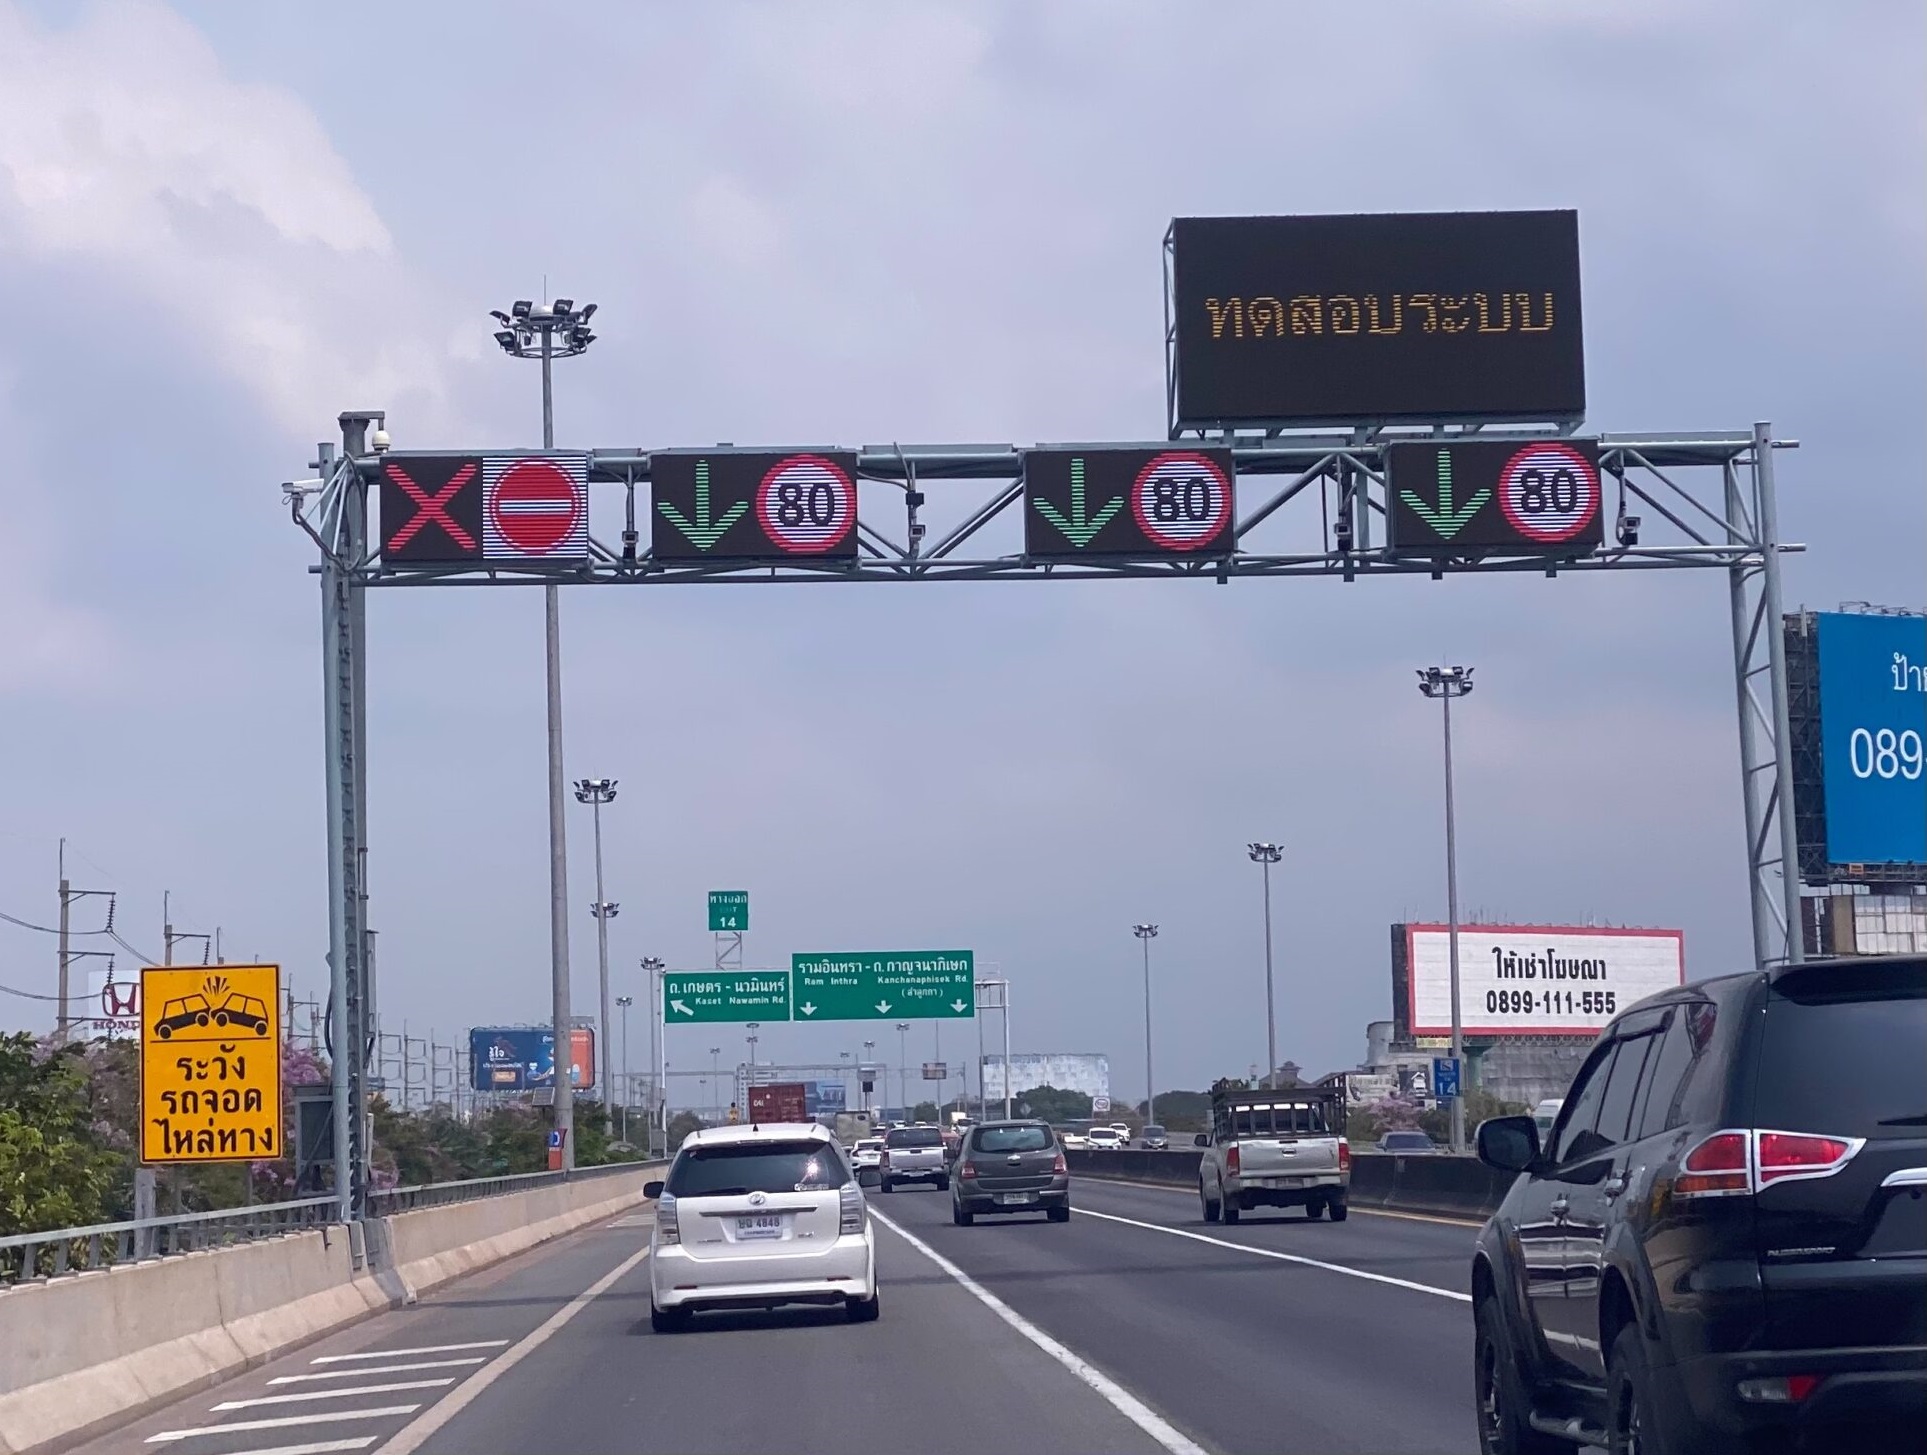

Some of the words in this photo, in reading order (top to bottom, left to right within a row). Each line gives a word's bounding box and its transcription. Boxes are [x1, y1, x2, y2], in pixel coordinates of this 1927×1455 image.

[1205, 292, 1555, 338] ทดสอบระบบ
[778, 482, 834, 527] 80
[1153, 477, 1210, 522] 80
[1520, 468, 1577, 513] 80
[1850, 727, 1927, 780] 089
[720, 916, 737, 928] 14
[798, 958, 863, 974] รามอินทรา
[886, 956, 968, 975] กาญจนาภิเษก
[1491, 946, 1607, 980] ให้เช่าโฆษณา
[683, 982, 722, 993] เกษตร
[735, 977, 785, 993] นวมินทร์
[804, 977, 824, 986] Ram
[830, 977, 858, 985] Inthra
[877, 975, 950, 985] Kanchanaphisek
[695, 997, 722, 1005] Kaset
[729, 996, 769, 1005] Nawamin
[1486, 989, 1616, 1015] 0899-111-555
[93, 1020, 140, 1030] HOND
[176, 1043, 245, 1082] ระวัง
[160, 1087, 262, 1115] รถจอด
[1439, 1081, 1457, 1096] 14
[152, 1117, 273, 1154] ไหล่ทาง
